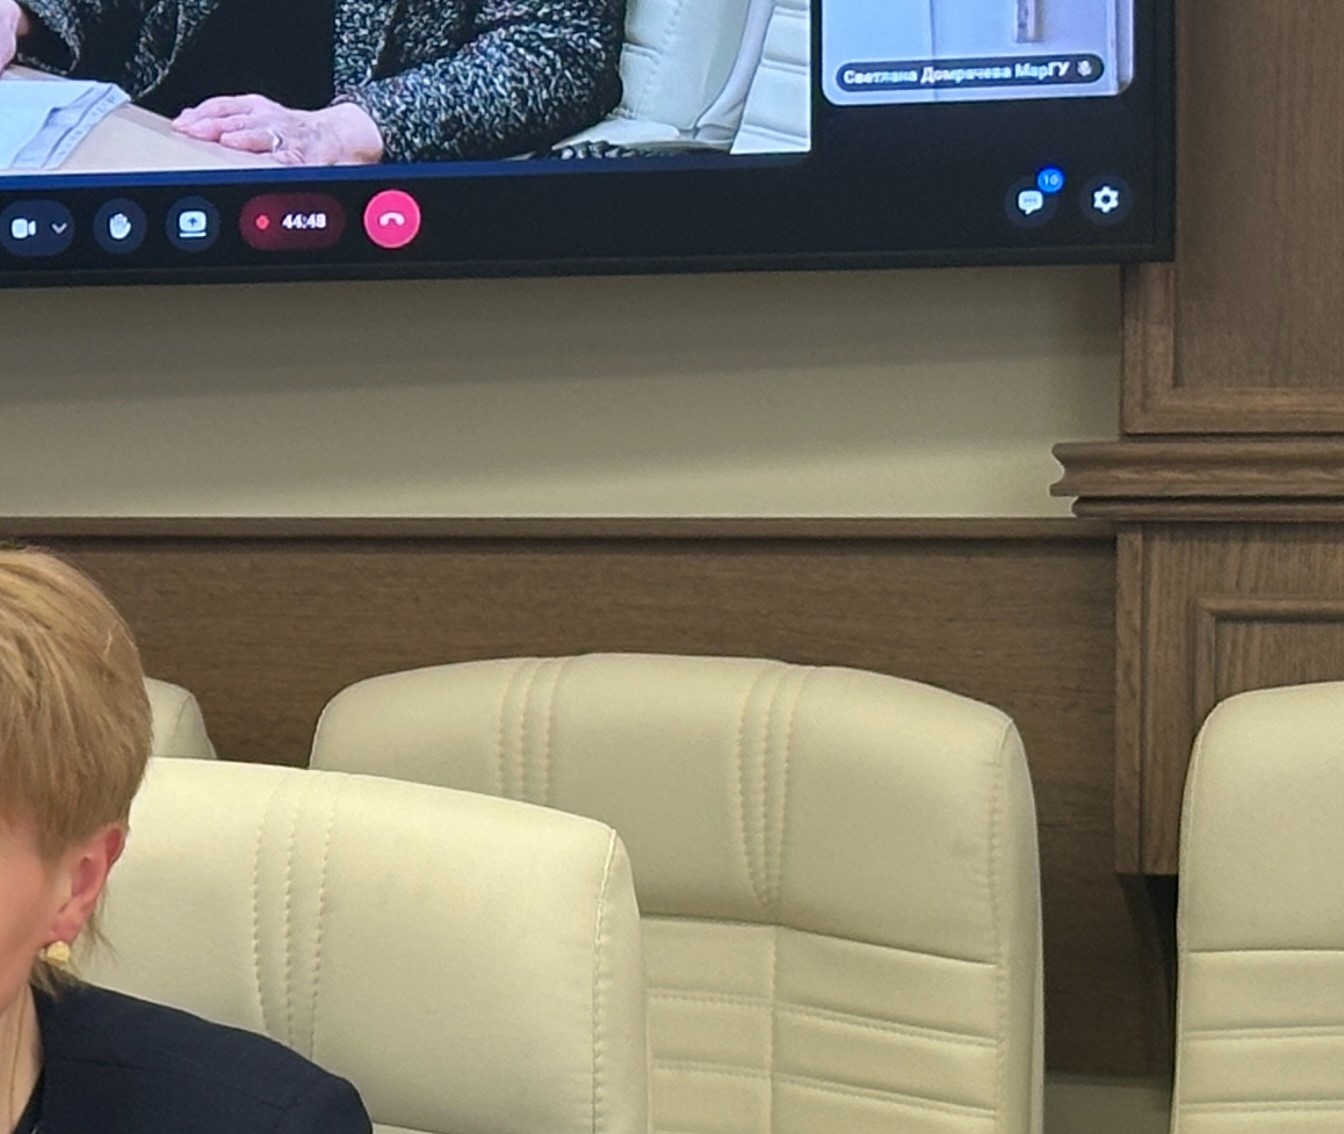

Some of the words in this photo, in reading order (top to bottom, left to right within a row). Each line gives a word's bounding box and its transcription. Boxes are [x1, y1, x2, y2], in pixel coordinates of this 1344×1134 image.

[843, 69, 918, 85] Светлана
[920, 66, 1011, 84] Домрачева
[1014, 60, 1070, 80] МарГУ
[282, 213, 327, 229] 44:48
